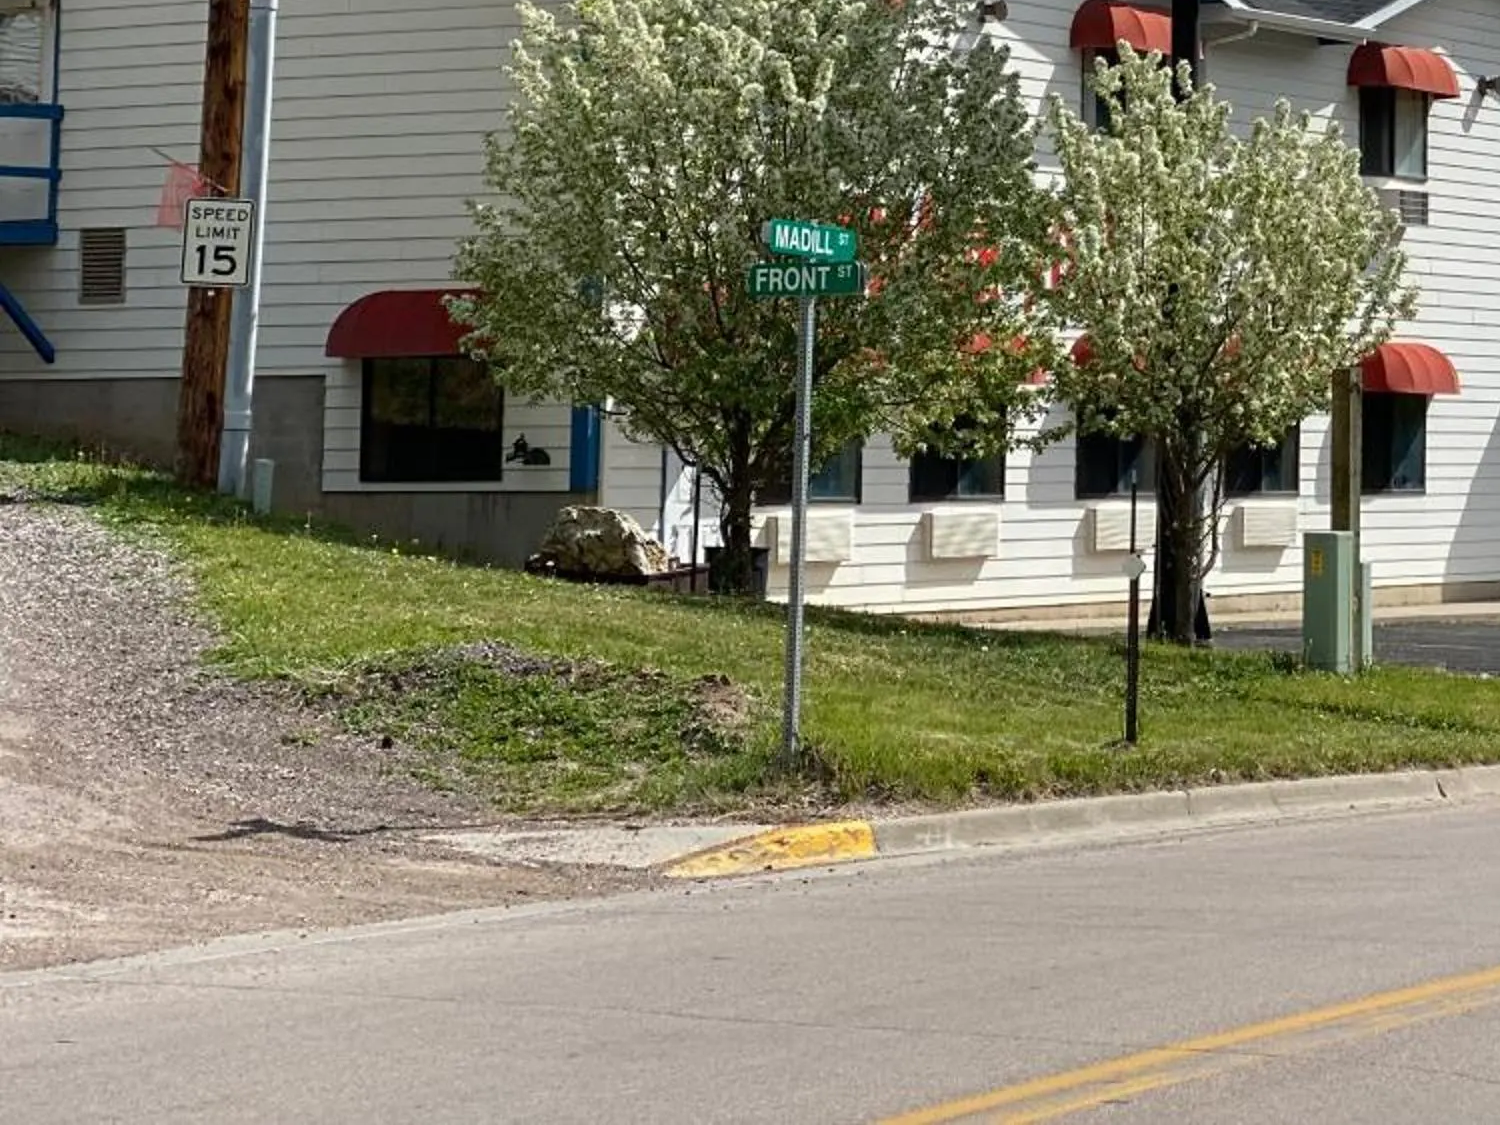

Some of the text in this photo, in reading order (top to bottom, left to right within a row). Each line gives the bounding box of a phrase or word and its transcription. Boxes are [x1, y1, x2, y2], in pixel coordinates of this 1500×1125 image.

[191, 206, 249, 222] SPEED
[195, 226, 241, 240] LIMIT
[775, 224, 850, 255] MADILL ST
[196, 244, 237, 276] 15
[755, 265, 853, 292] FRONT ST
